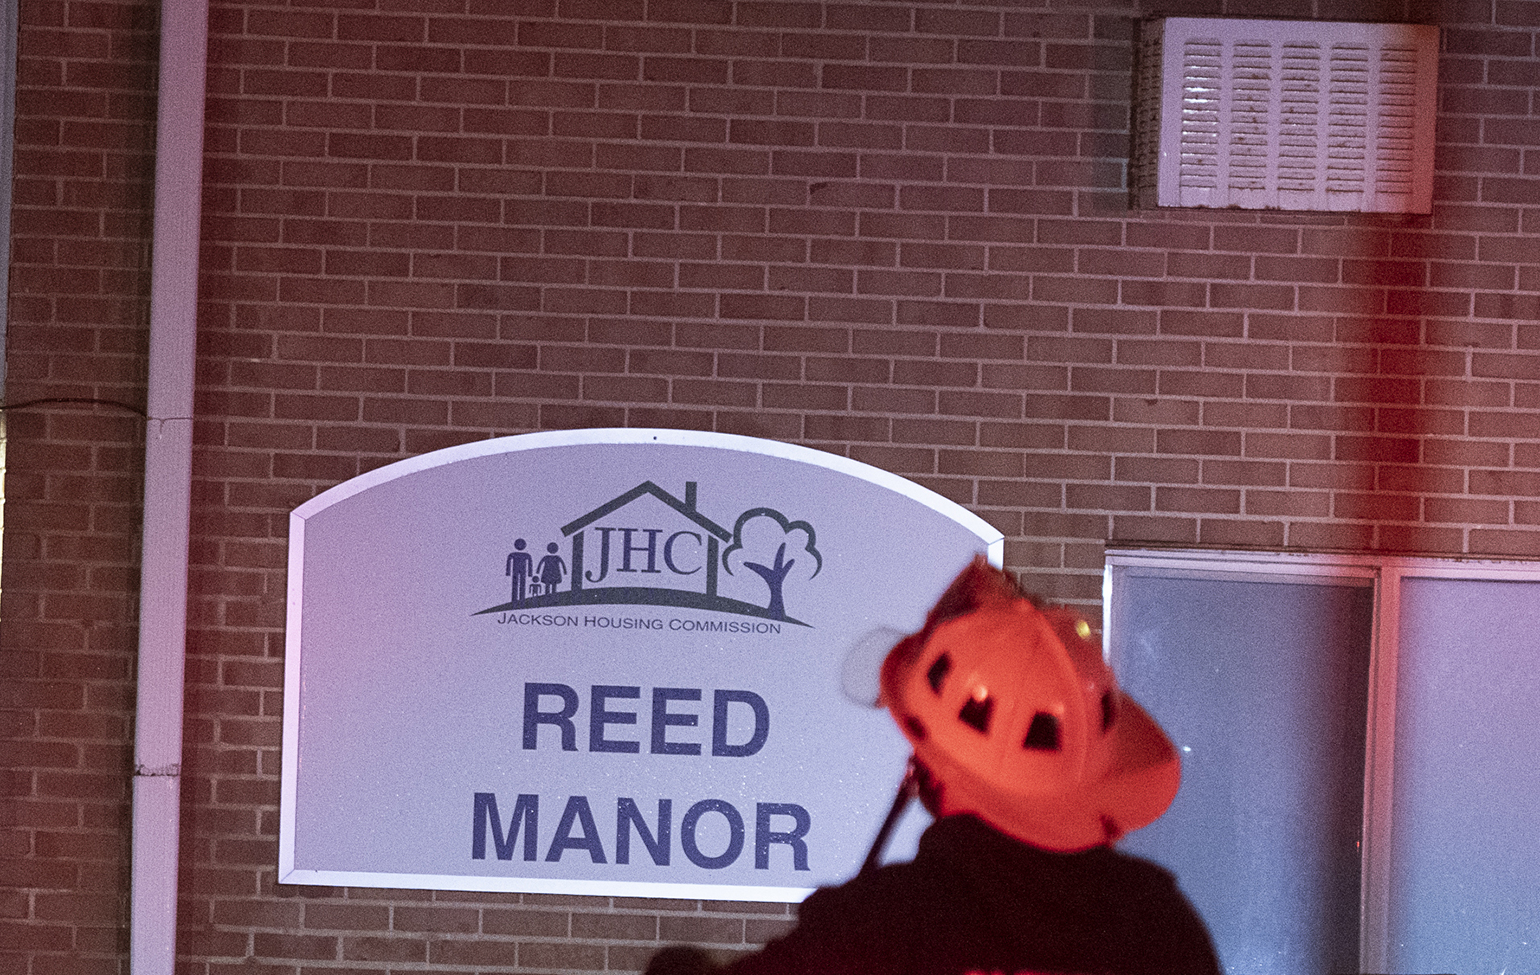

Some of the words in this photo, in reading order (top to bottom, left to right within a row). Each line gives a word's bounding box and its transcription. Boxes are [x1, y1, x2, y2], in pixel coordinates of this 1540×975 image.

[584, 526, 704, 584] JHC
[497, 611, 580, 628] JACKSON
[583, 614, 664, 632] HOUSING
[668, 617, 782, 636] COMMISSION
[522, 681, 771, 758] REED
[471, 792, 812, 872] MANOR
